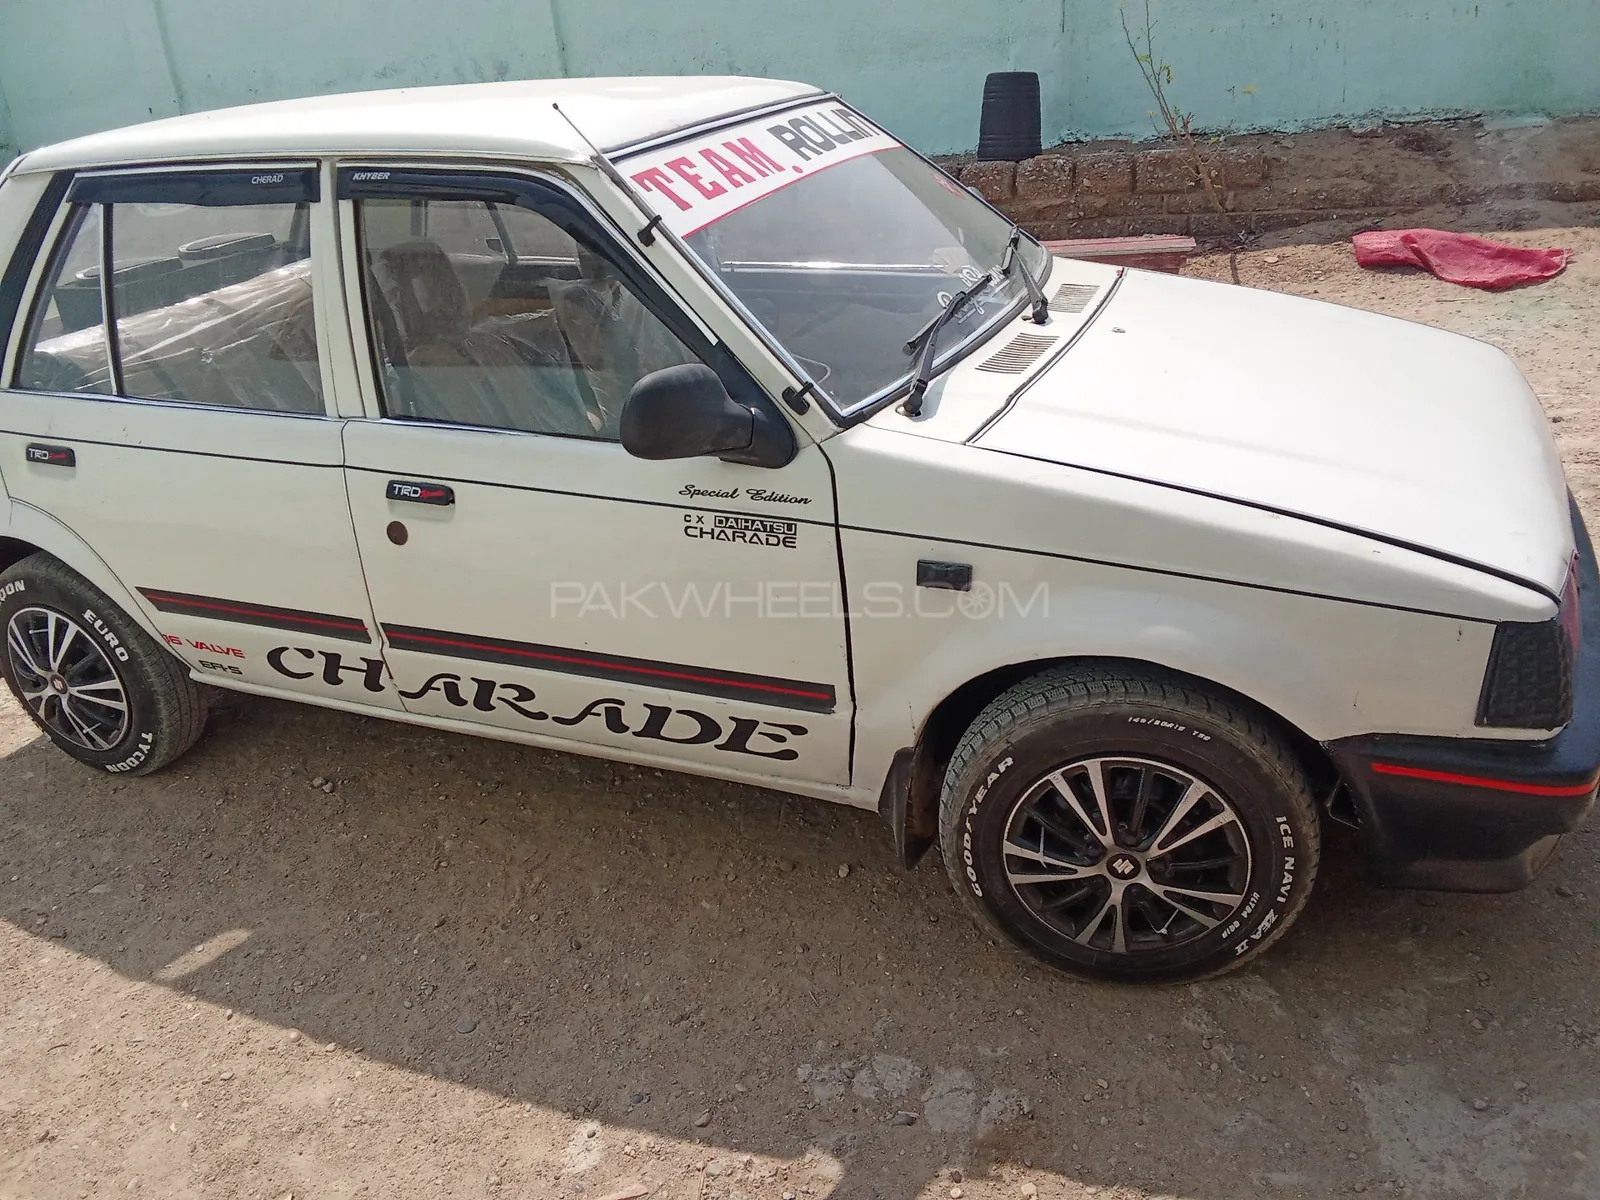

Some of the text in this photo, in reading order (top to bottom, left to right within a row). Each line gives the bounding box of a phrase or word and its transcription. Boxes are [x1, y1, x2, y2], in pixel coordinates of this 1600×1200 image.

[251, 174, 284, 185] CHERAD
[352, 171, 391, 181] KHYBER
[28, 447, 50, 460] TRD
[392, 483, 422, 498] TRD
[678, 484, 813, 505] Special Edition
[683, 525, 797, 549] CHARADE
[715, 516, 797, 536] DAIHATSU
[82, 609, 130, 662] EURO
[185, 638, 246, 659] VALVE
[266, 645, 809, 761] CHARADE
[105, 732, 153, 774] TYCOON
[963, 756, 1014, 898] GOODYEAR
[1275, 815, 1295, 849] ICE
[1276, 856, 1296, 903] NAVI
[1250, 908, 1279, 940] ZEA
